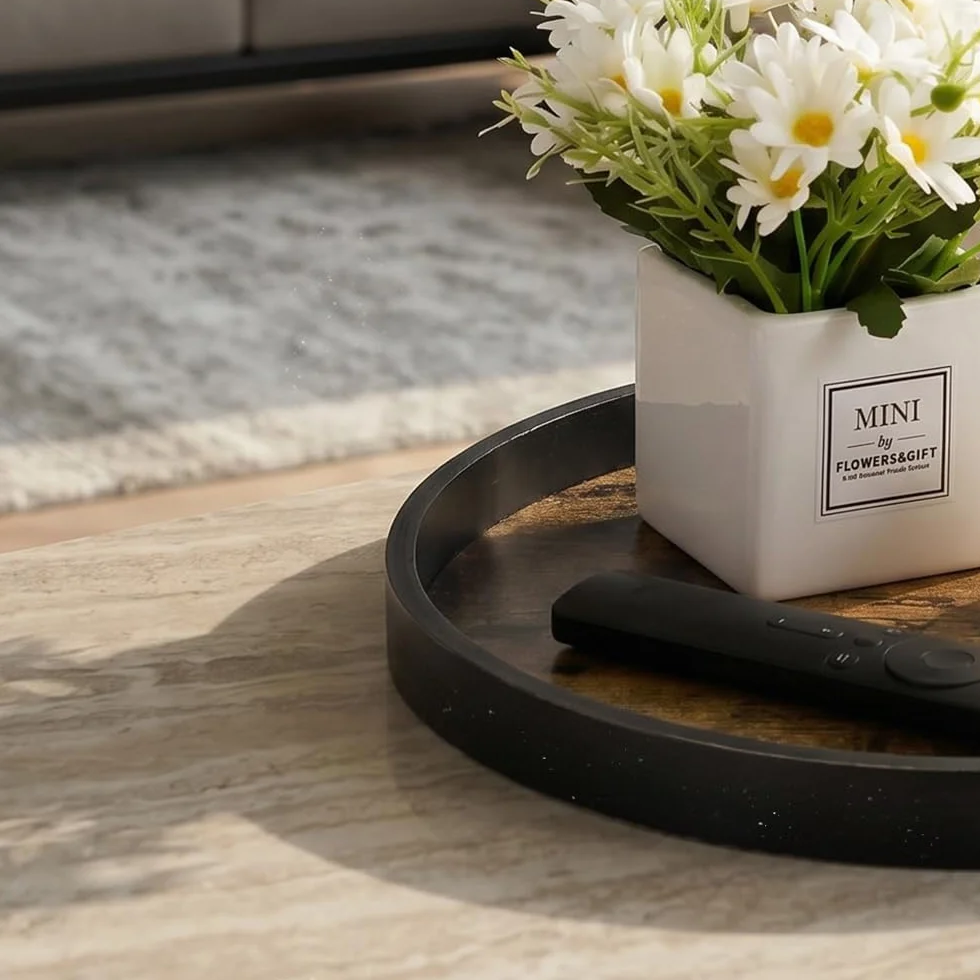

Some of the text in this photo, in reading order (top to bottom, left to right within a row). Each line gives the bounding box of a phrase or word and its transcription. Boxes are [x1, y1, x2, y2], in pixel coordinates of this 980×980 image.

[854, 399, 921, 431] MINI
[877, 435, 893, 450] by
[836, 447, 937, 473] FLOWERS&GIFT
